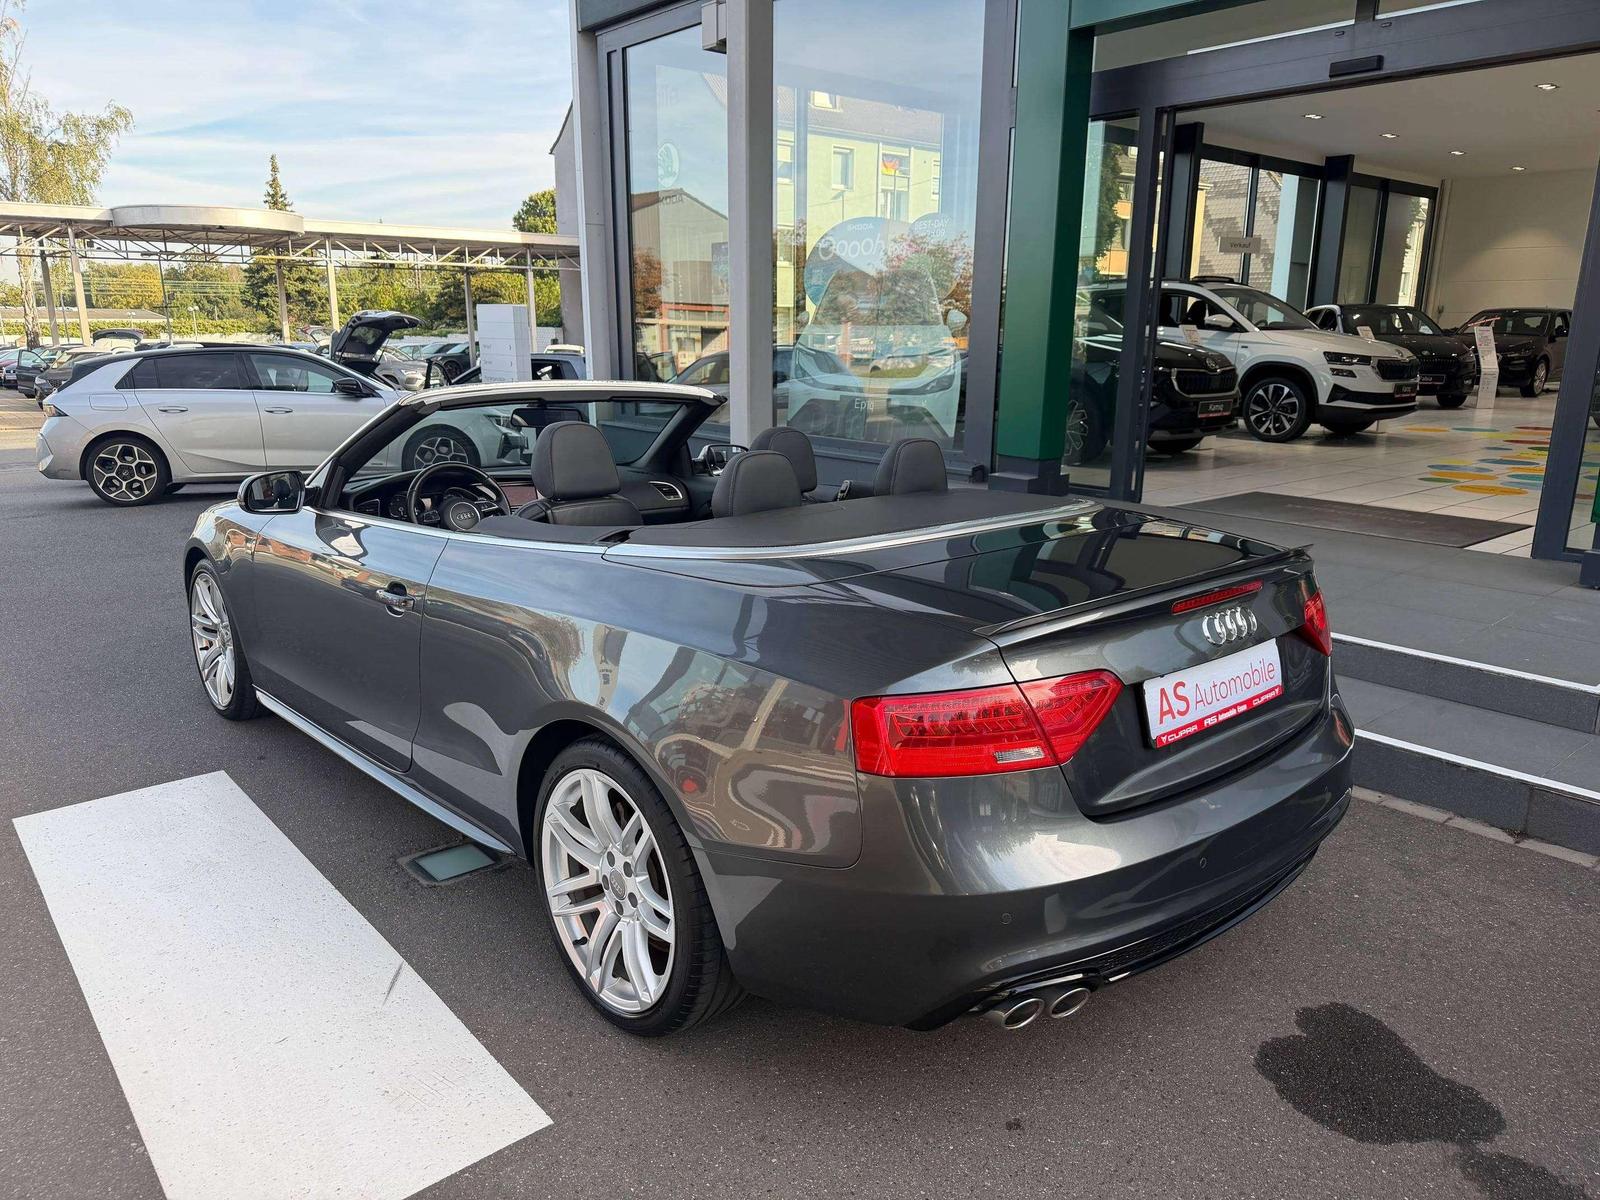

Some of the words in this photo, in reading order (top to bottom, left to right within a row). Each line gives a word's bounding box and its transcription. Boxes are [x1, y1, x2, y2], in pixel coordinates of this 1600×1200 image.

[1158, 681, 1191, 725] AS
[1195, 658, 1275, 711] Automobile
[1168, 725, 1198, 742] CUPRA
[1252, 691, 1276, 706] CUPRA
